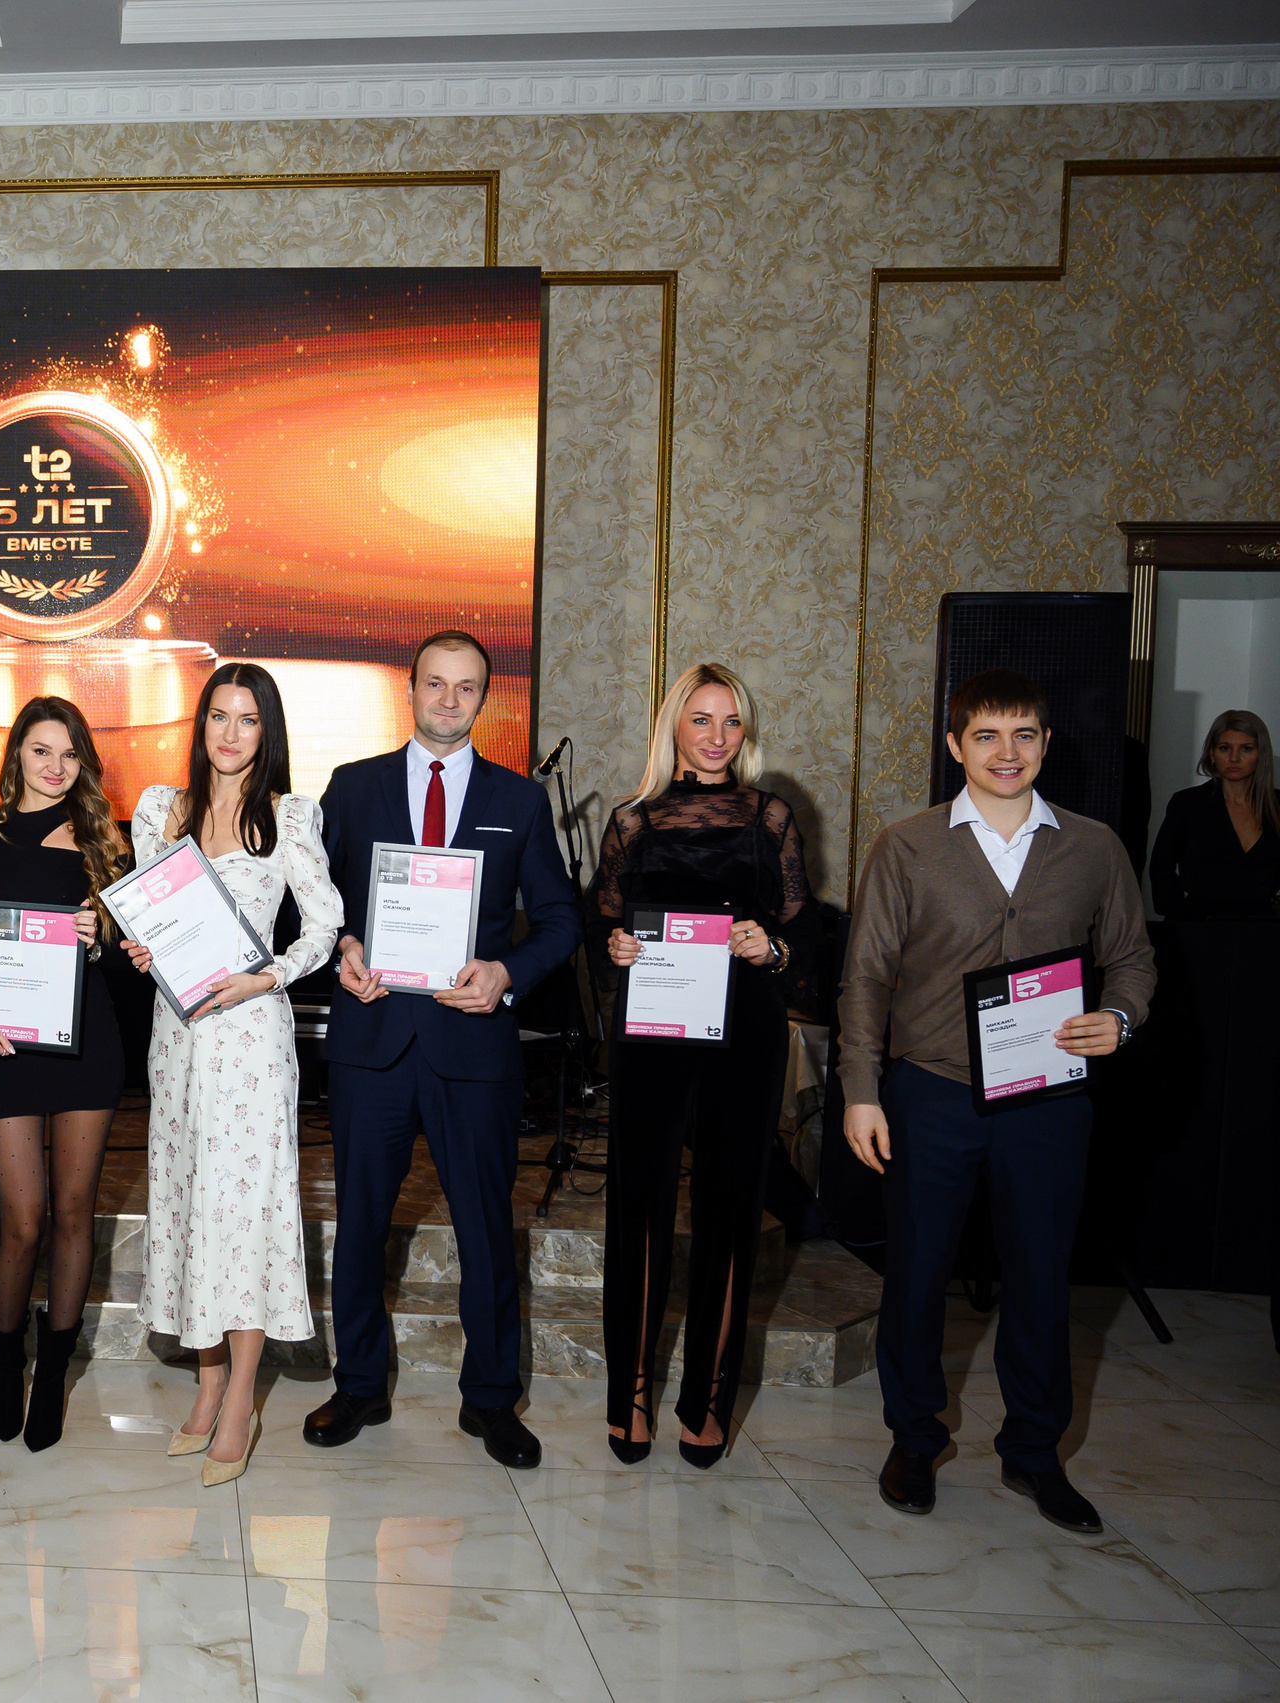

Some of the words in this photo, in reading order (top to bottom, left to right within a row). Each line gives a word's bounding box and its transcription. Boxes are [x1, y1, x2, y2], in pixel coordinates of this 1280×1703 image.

[24, 446, 71, 480] t2
[32, 498, 111, 524] ЛЕТ
[7, 537, 91, 551] ВМЕСТЕ
[415, 862, 437, 883] 5
[146, 873, 172, 899] 5
[25, 918, 46, 940] 5
[670, 920, 694, 940] 5
[1016, 974, 1041, 997] 5
[986, 1018, 1014, 1028] МИХАИЛ
